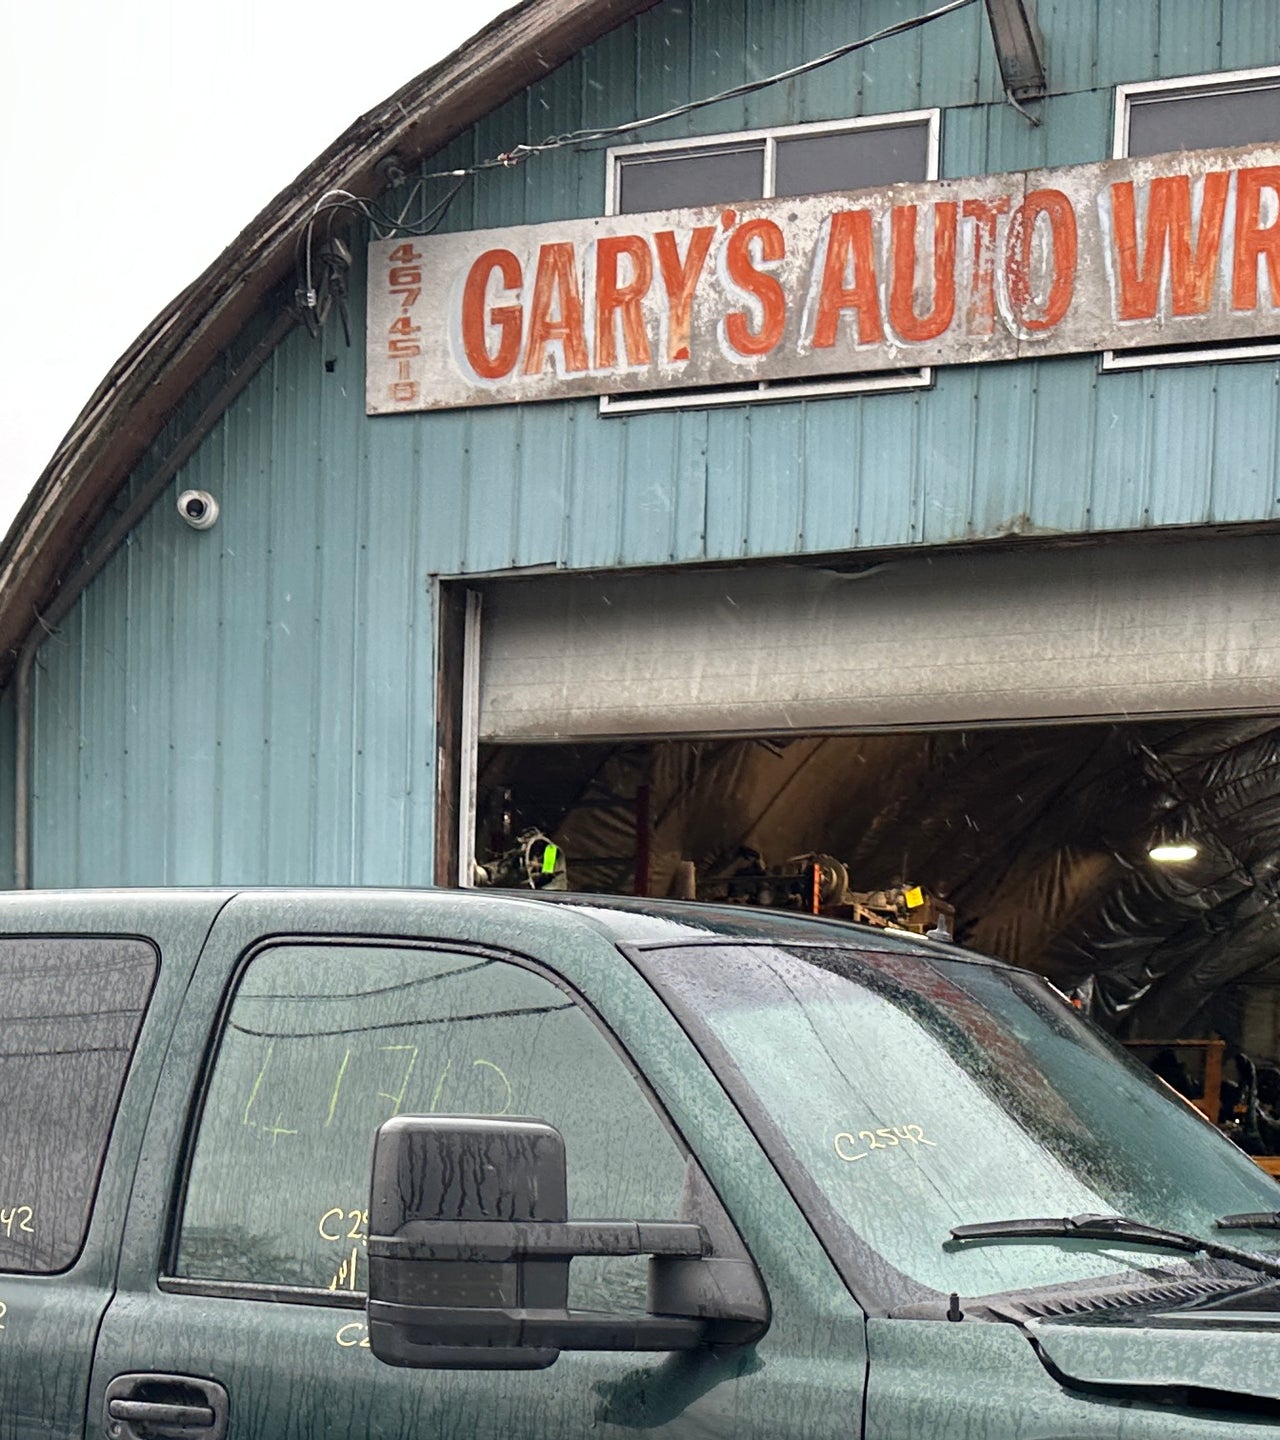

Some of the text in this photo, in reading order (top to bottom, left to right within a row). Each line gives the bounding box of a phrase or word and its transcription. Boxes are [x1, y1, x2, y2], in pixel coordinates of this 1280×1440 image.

[460, 206, 788, 380] GARY'S
[808, 188, 1076, 350] AUTO
[834, 1124, 936, 1161] C2542
